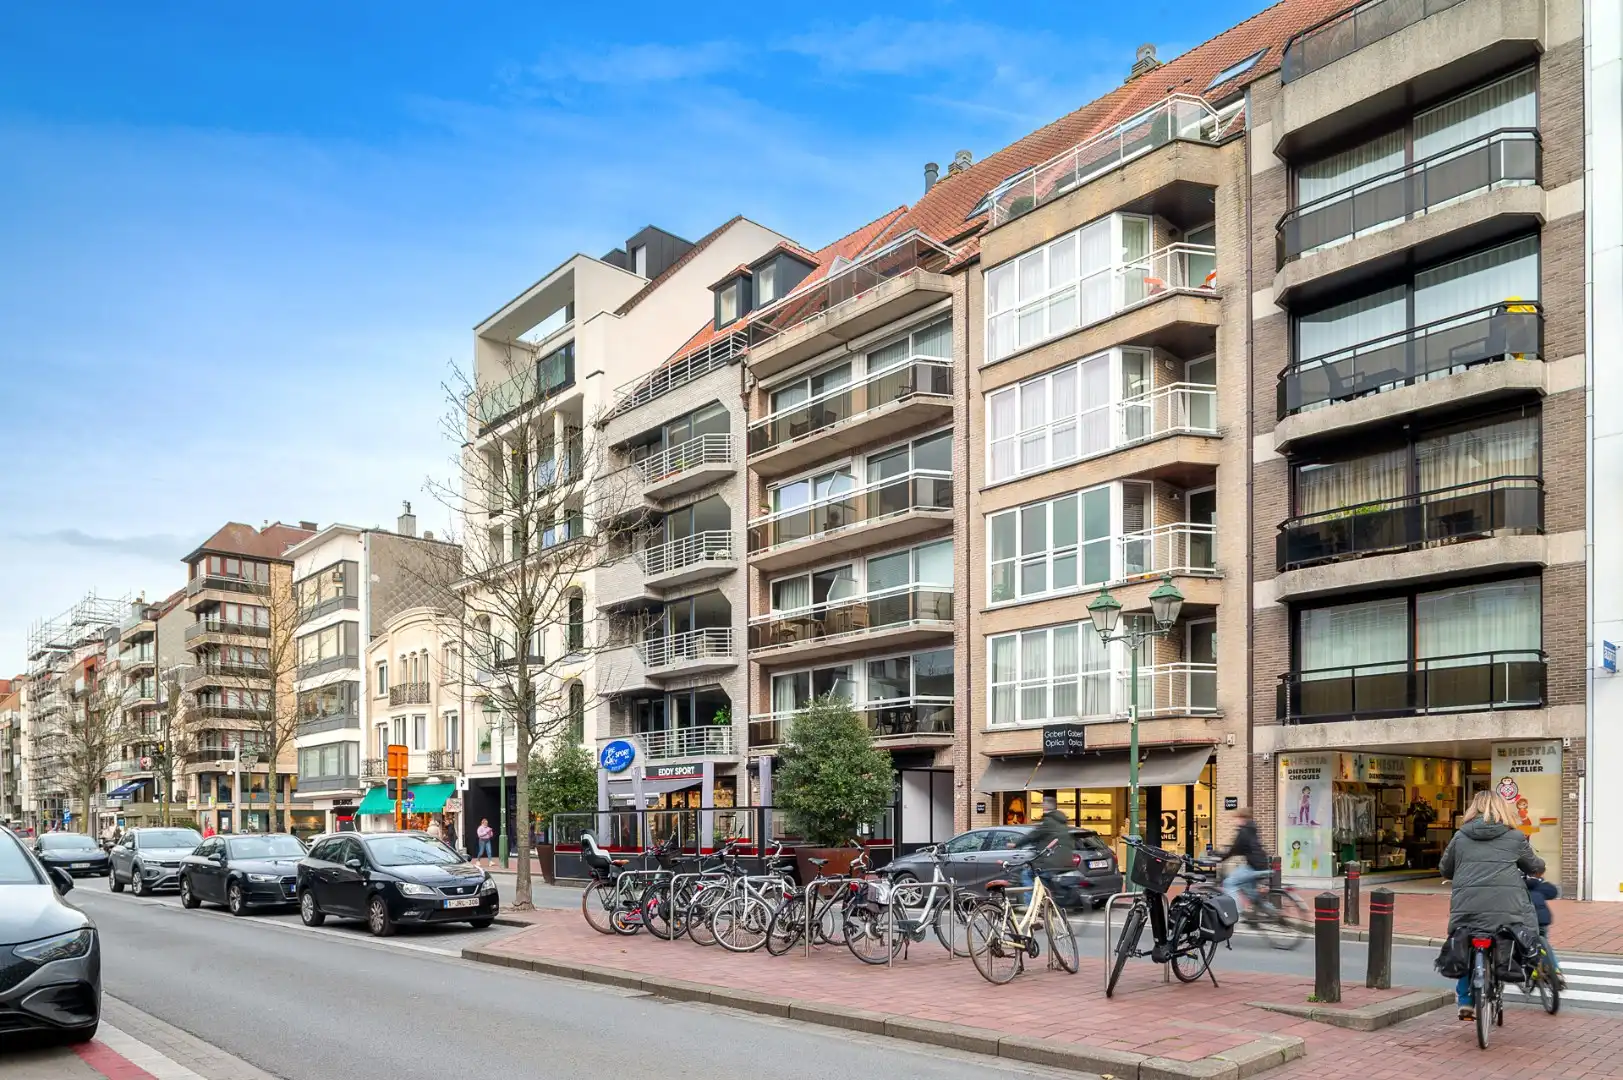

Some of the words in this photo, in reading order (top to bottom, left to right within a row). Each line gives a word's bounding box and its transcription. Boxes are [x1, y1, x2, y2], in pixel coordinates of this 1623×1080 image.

[1045, 730, 1066, 738] Gobert
[1045, 739, 1065, 747] Optics
[1508, 745, 1557, 757] HESTIA
[1289, 756, 1327, 766] HESTIA
[1376, 758, 1405, 772] HESTIA
[1511, 758, 1541, 766] STRIJK
[658, 767, 674, 776] EDDY
[674, 766, 695, 775] SPORT
[1288, 767, 1321, 775] DIENSTEN
[1509, 765, 1543, 773] ATELIER
